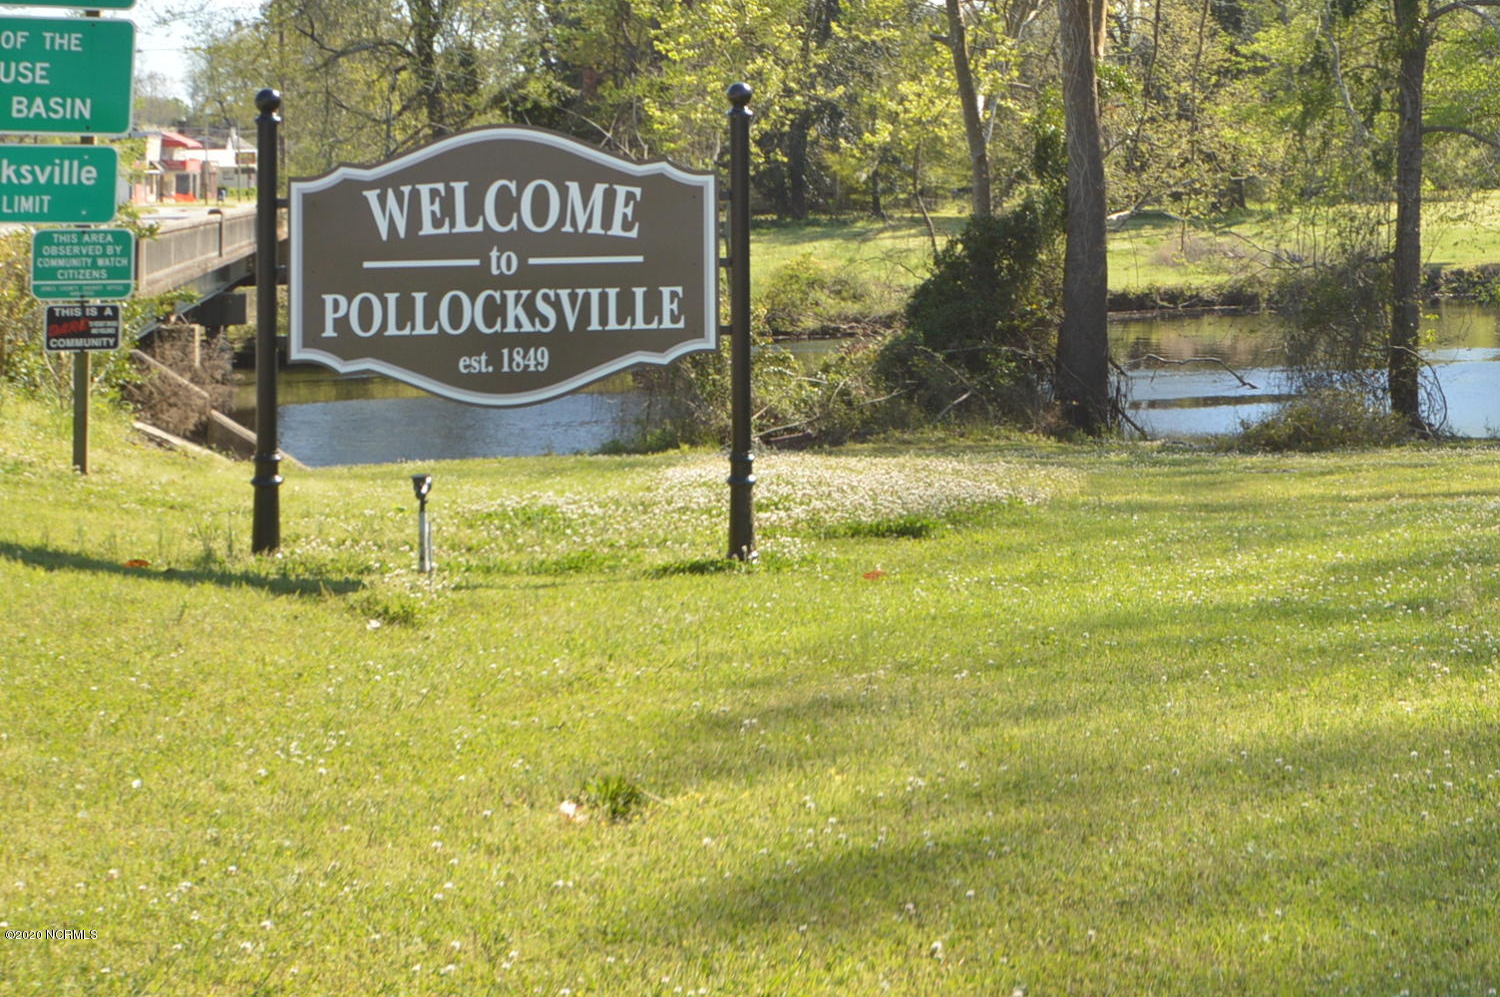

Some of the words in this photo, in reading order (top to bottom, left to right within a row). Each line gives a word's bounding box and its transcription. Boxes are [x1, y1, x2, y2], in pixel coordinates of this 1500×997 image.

[1, 30, 30, 50] OF
[42, 31, 83, 51] THE
[11, 95, 91, 120] BASIN
[2, 194, 51, 214] LIMIT
[362, 179, 642, 242] WELCOME
[53, 234, 78, 243] THIS
[82, 233, 114, 243] AREA
[42, 246, 103, 256] OBSERVED
[106, 245, 122, 255] BY
[489, 245, 519, 276] to
[37, 257, 92, 268] COMMUNITY
[97, 257, 128, 267] WATCH
[57, 269, 108, 279] CITIZENS
[54, 307, 82, 317] THIS
[85, 307, 98, 316] IS
[103, 306, 113, 316] A
[321, 286, 686, 338] POLLOCKSVILLE
[49, 338, 116, 348] COMMUNITY
[458, 354, 493, 374] est.
[500, 346, 550, 373] 1849
